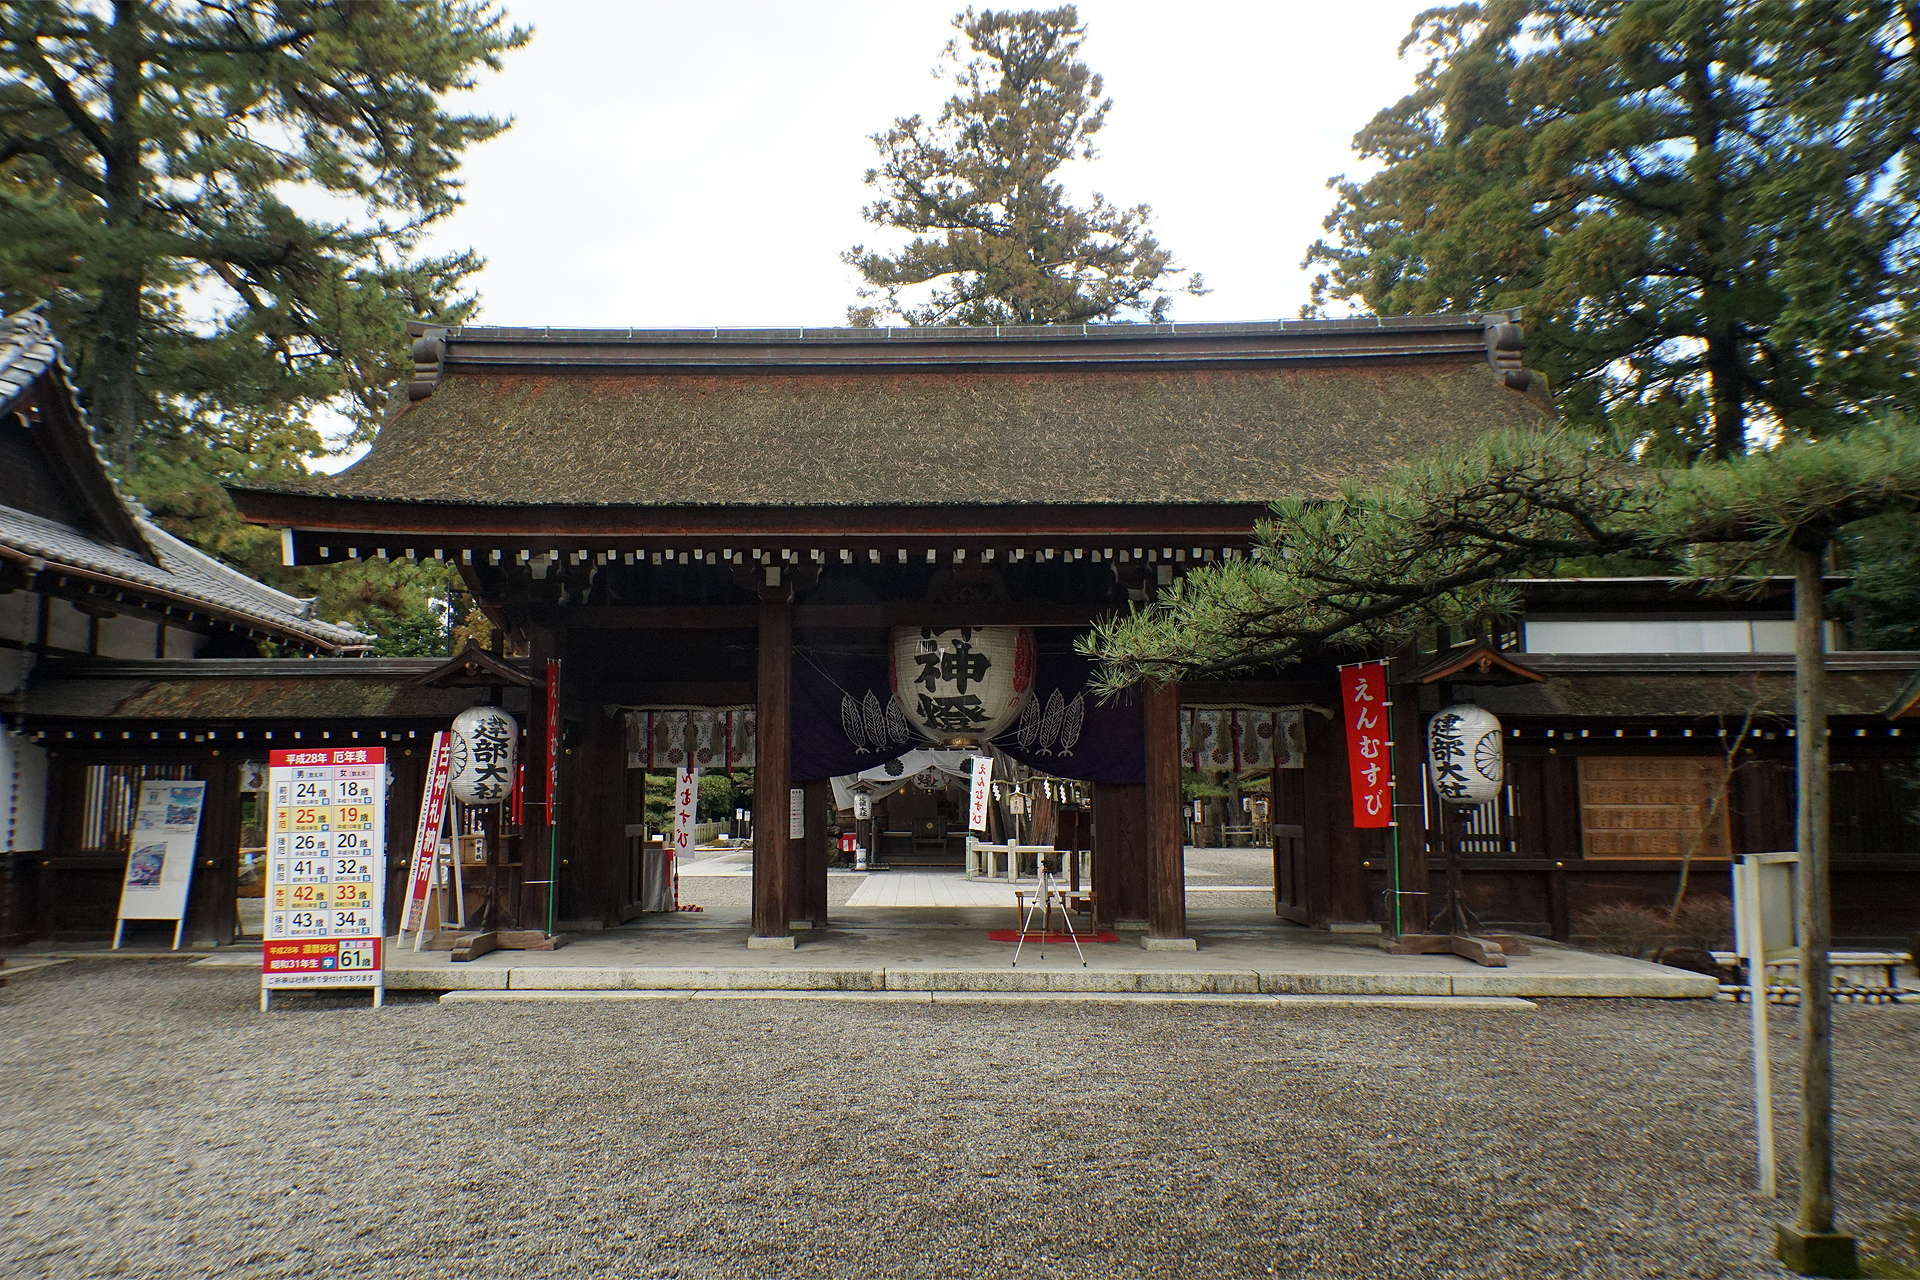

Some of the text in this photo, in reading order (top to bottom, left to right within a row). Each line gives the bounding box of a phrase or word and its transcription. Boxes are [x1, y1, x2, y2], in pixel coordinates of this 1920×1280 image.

[914, 627, 995, 733] 神燈
[286, 750, 367, 764] 平成28年 厄年表
[471, 715, 510, 799] 建部大社
[1354, 678, 1383, 815] えんむすび
[1431, 713, 1472, 799] 建部大社
[297, 770, 304, 779] 男
[340, 769, 347, 777] 女
[418, 743, 450, 882] 古神札納所
[269, 947, 299, 955] 平成28年
[270, 959, 333, 969] 昭和31年生 申
